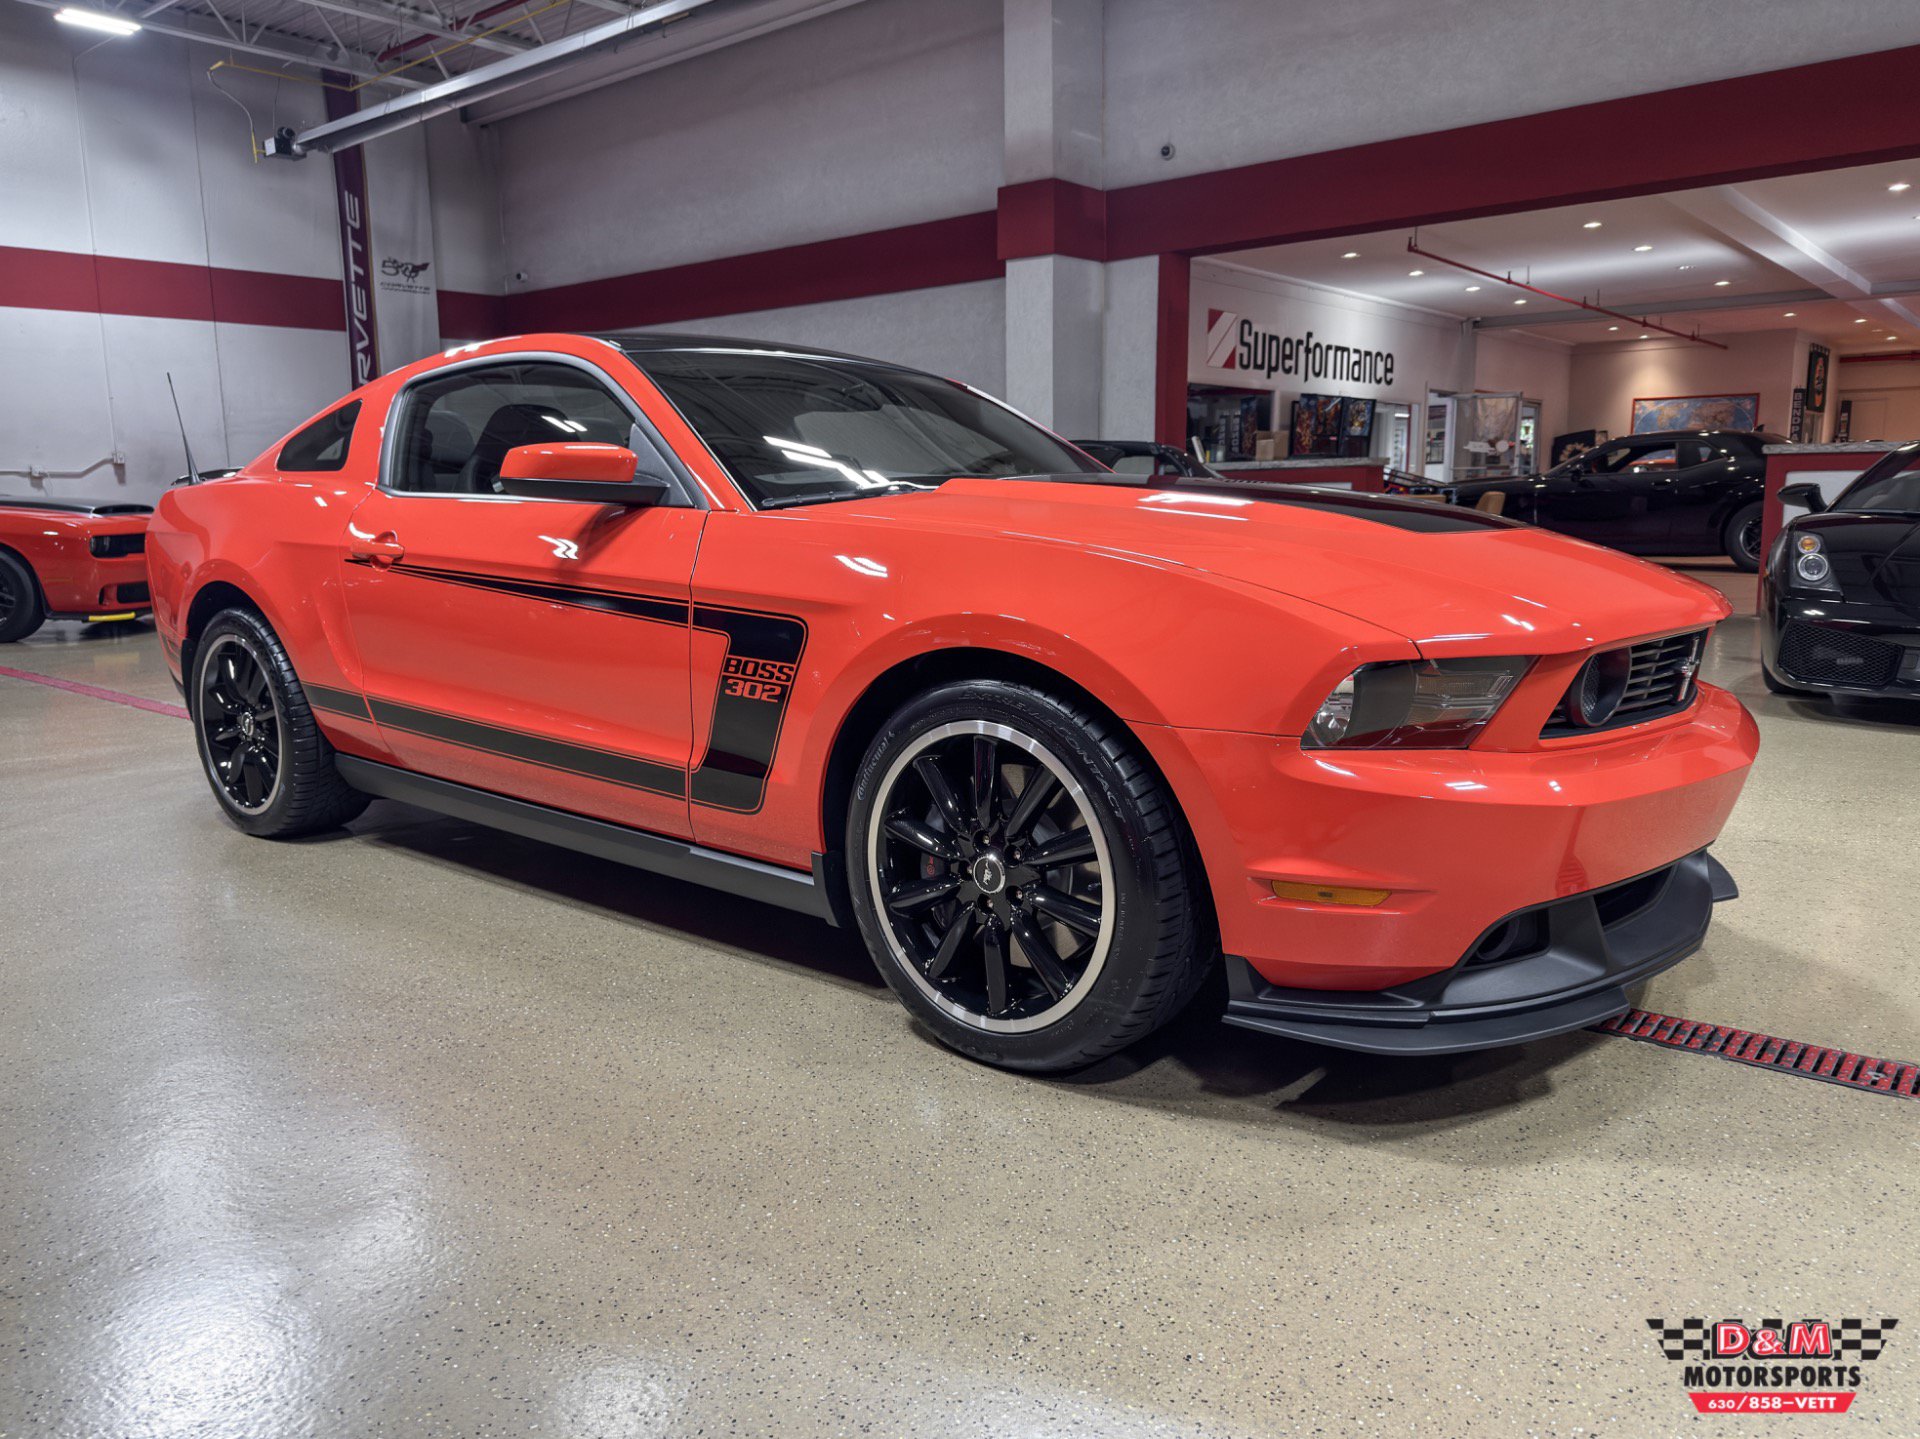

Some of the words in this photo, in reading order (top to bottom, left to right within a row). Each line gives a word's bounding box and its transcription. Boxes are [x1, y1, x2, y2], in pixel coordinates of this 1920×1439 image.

[1238, 319, 1395, 386] Superformance
[723, 657, 795, 683] BOSS
[724, 678, 782, 703] 302
[857, 737, 890, 801] Continental
